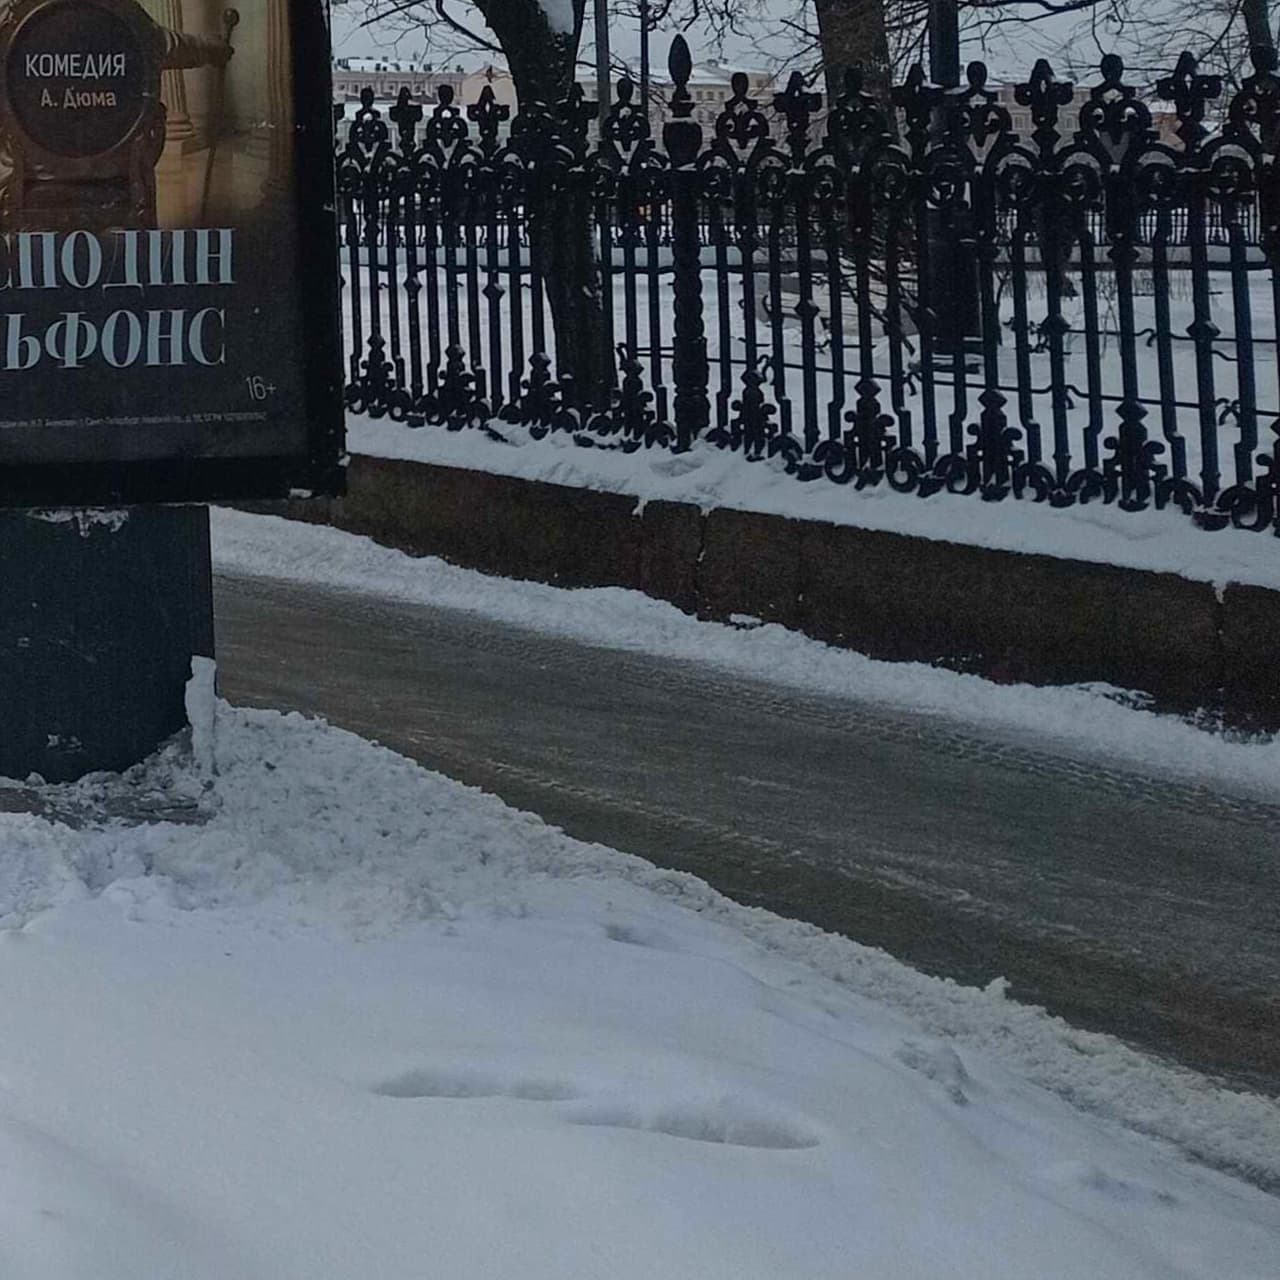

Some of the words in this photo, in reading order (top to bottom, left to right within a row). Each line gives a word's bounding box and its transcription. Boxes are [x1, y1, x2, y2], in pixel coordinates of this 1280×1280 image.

[25, 53, 126, 80] КОМЕДИЯ
[41, 88, 58, 107] А.
[63, 87, 117, 109] Дюма
[246, 375, 277, 401] 16+
